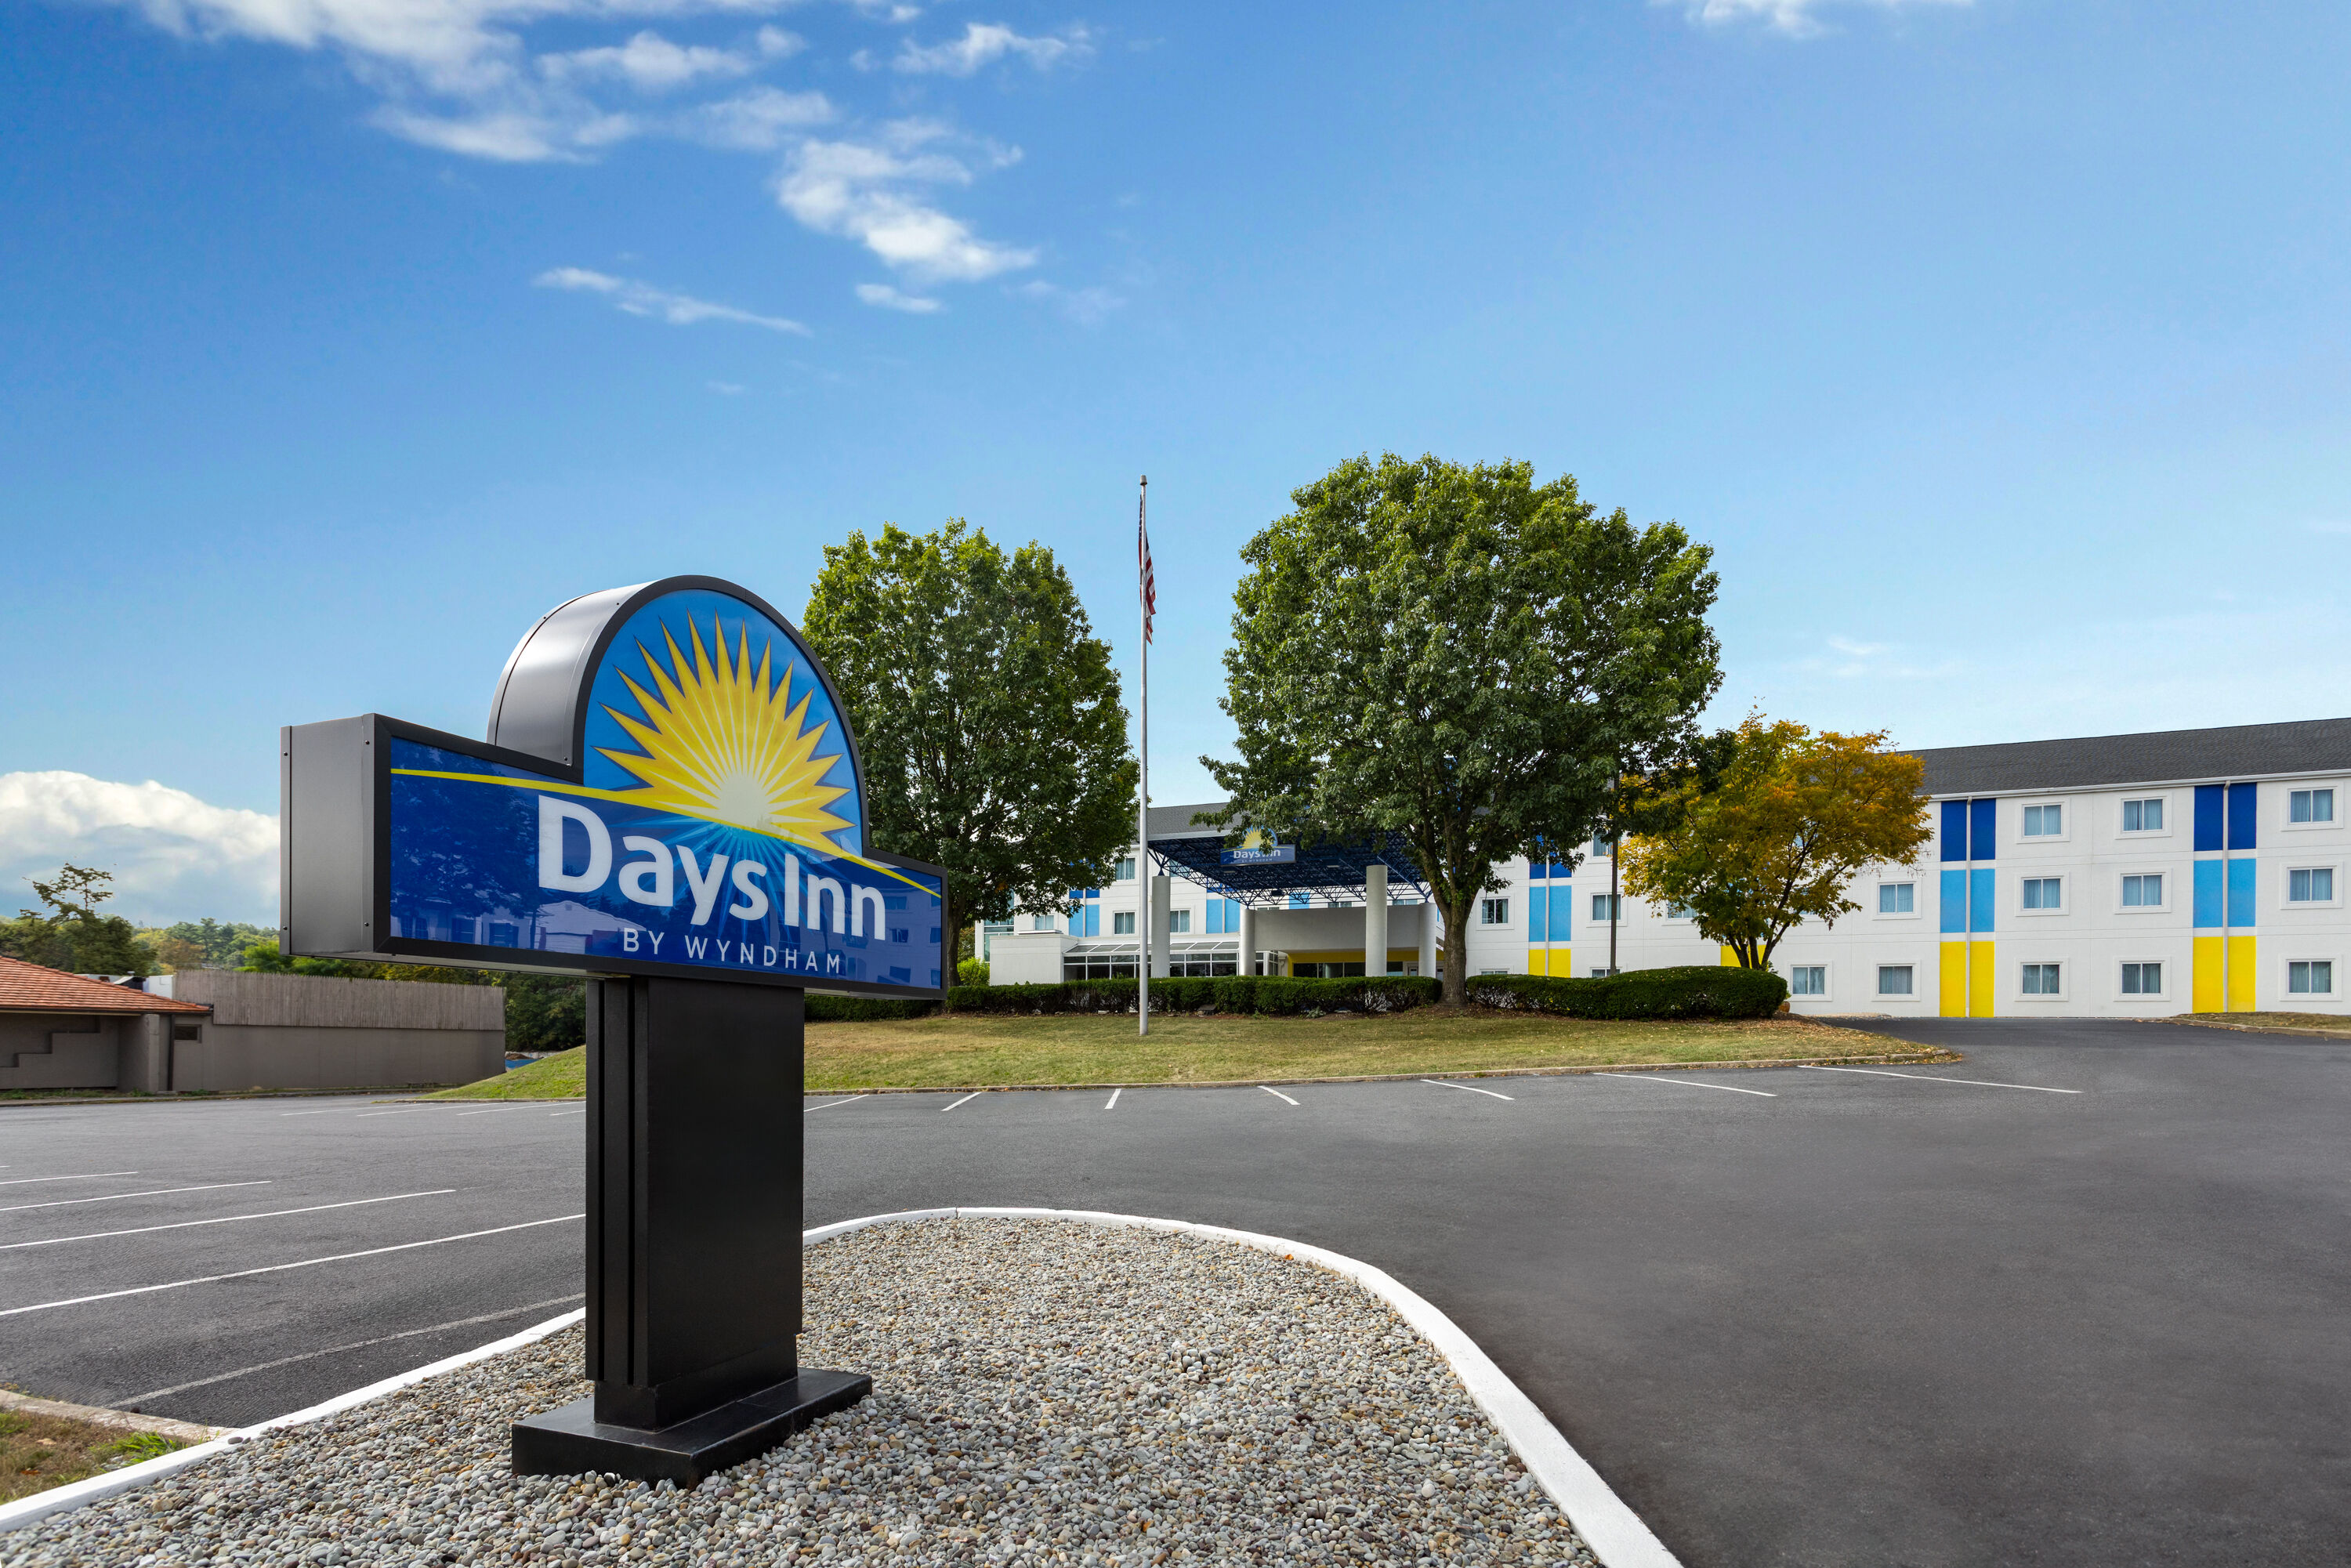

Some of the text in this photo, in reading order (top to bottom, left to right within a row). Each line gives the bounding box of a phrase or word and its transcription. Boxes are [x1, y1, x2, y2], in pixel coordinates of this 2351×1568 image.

[538, 795, 886, 941] Days Inn
[1233, 850, 1261, 859] Days
[624, 928, 840, 974] BY WYNDHAM
